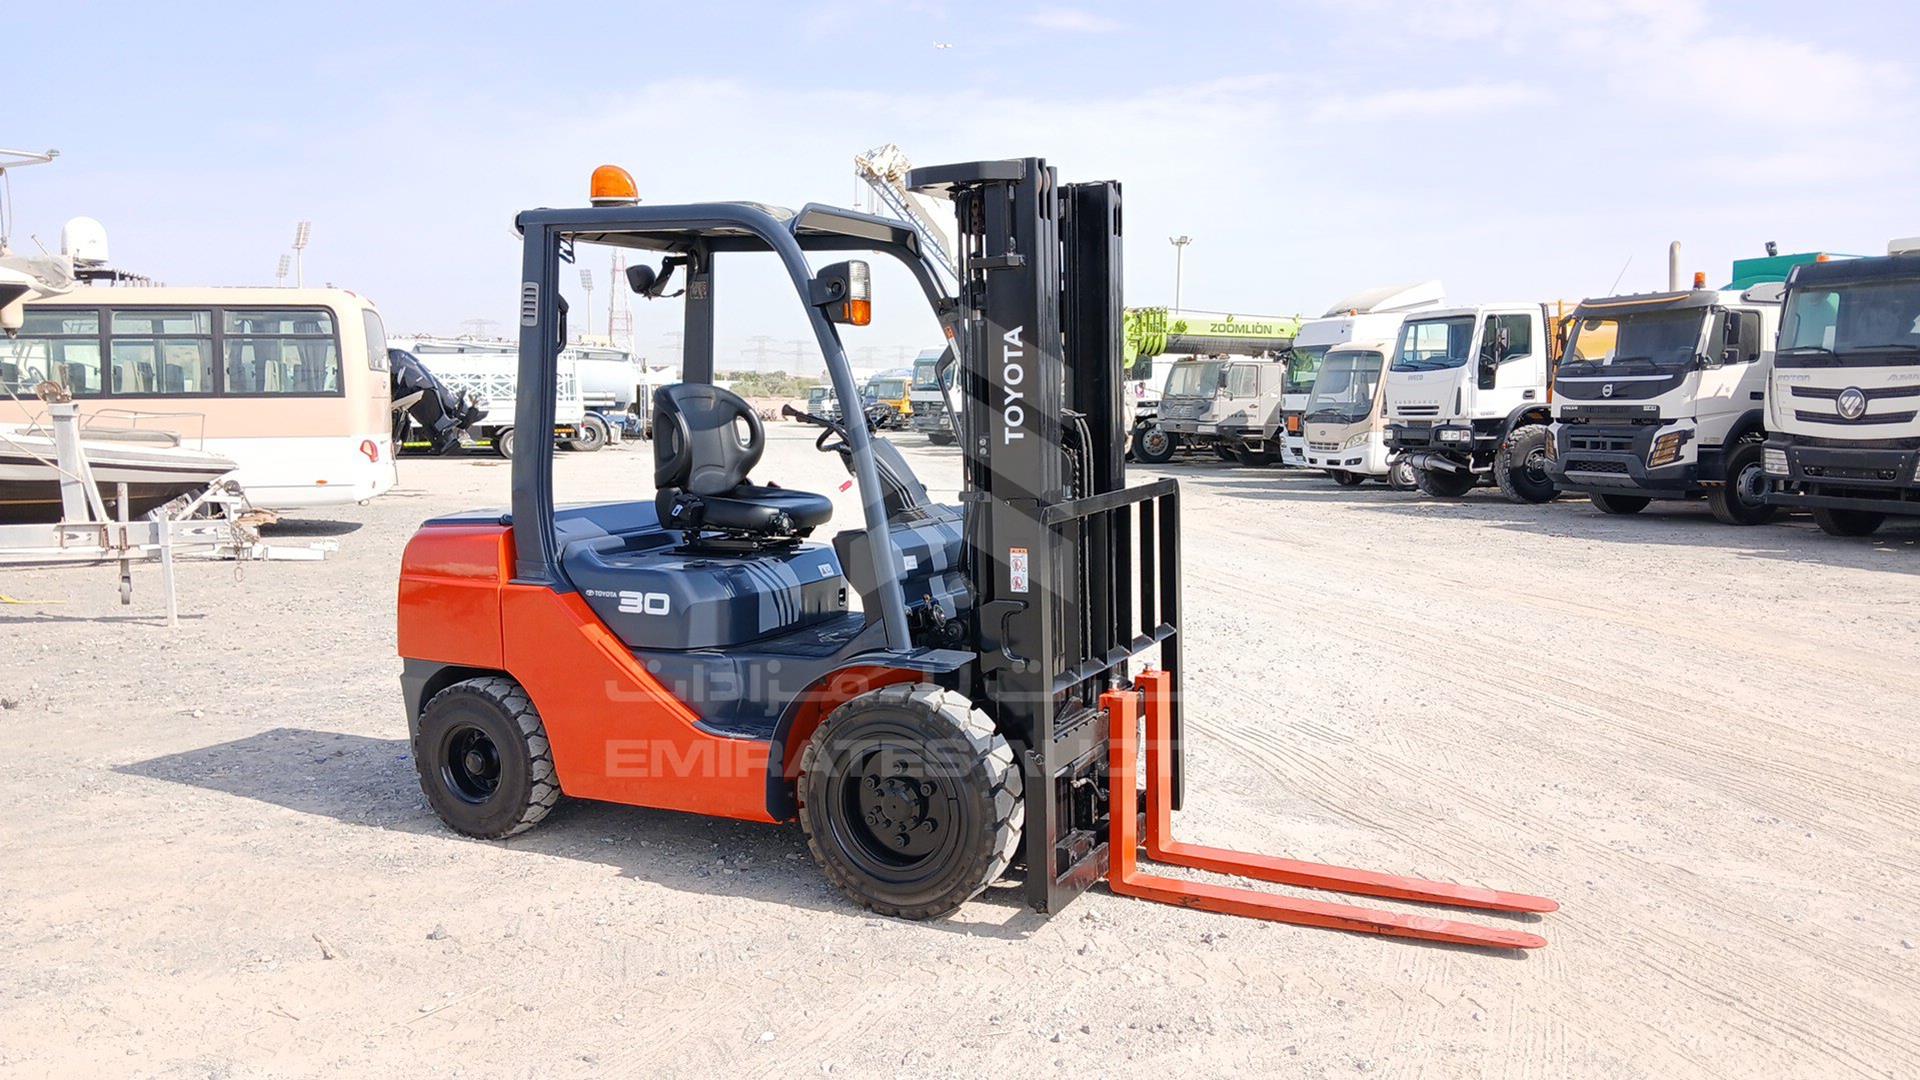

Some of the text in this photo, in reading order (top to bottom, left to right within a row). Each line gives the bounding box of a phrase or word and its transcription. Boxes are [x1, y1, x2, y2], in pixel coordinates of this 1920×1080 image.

[1210, 322, 1273, 334] ZOOMLION
[1003, 325, 1025, 445] TOYOTA
[595, 590, 670, 616] TOYOTA 30
